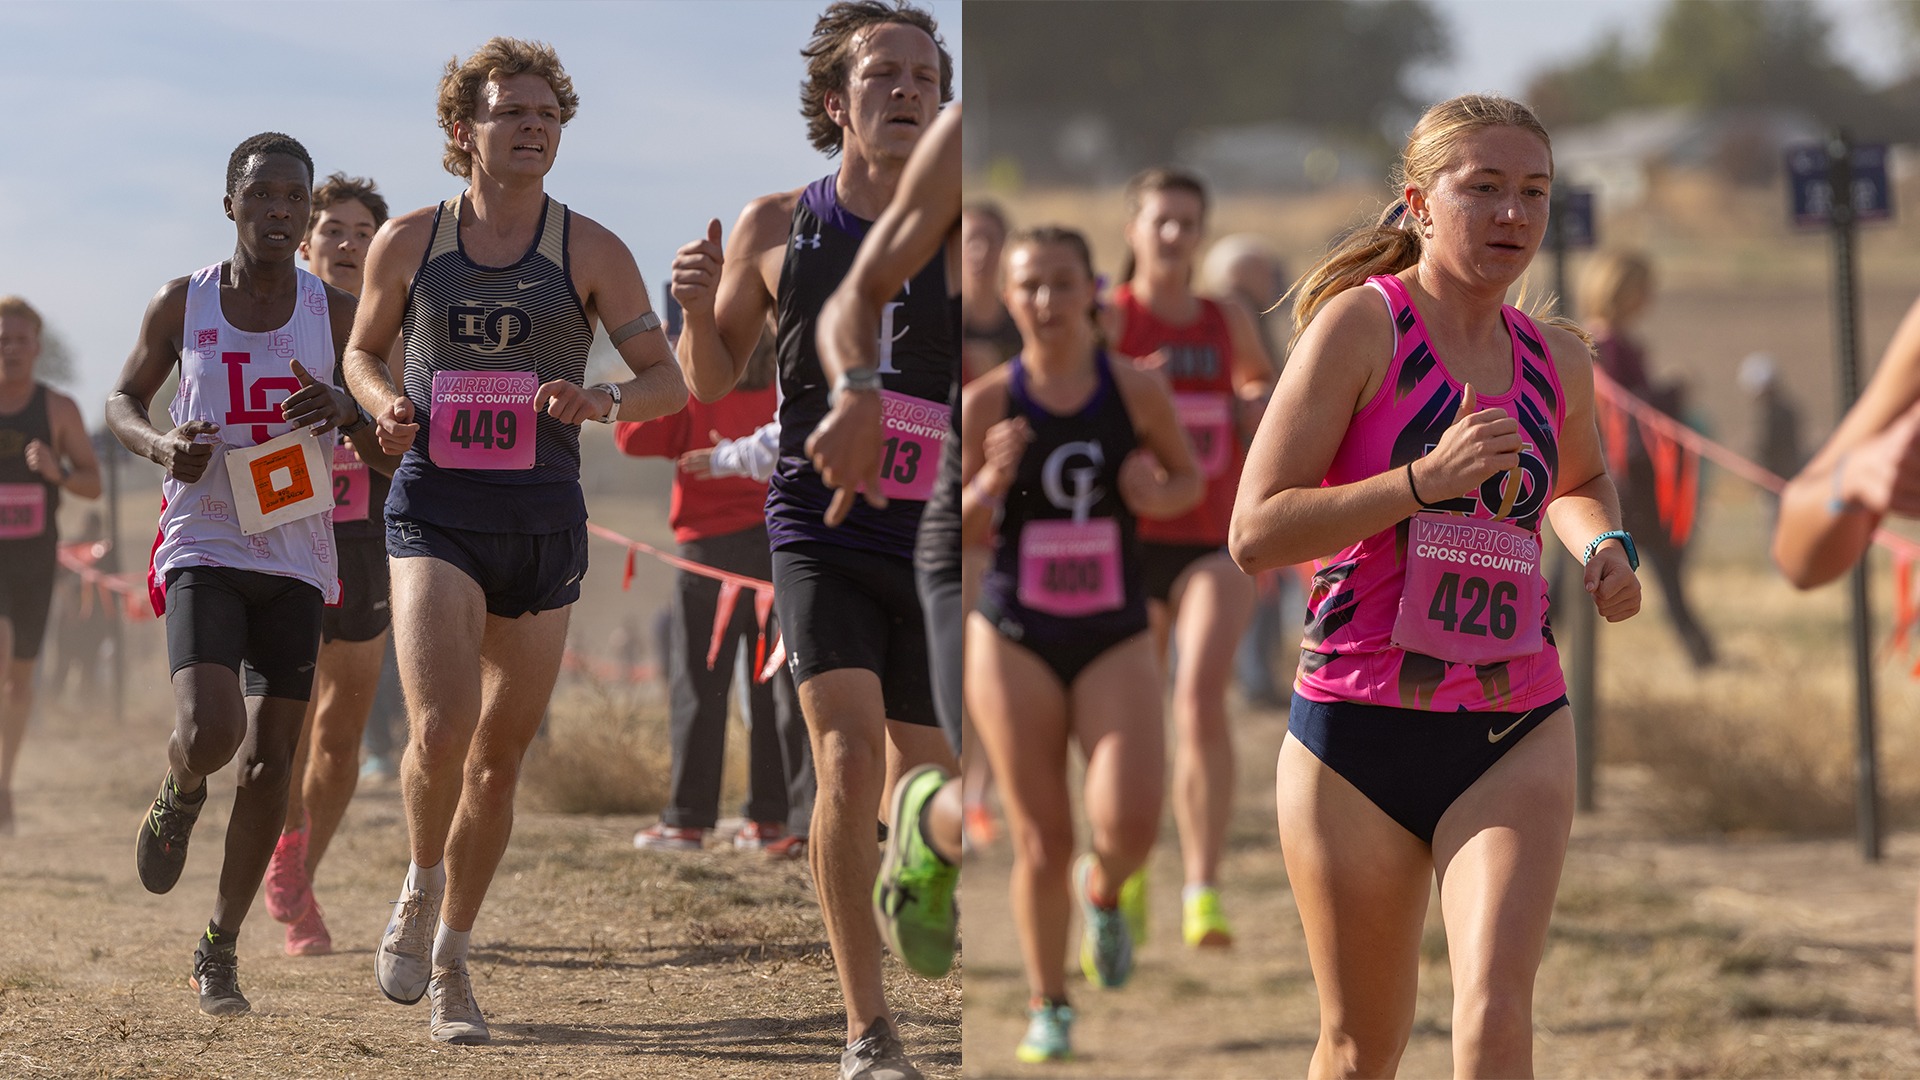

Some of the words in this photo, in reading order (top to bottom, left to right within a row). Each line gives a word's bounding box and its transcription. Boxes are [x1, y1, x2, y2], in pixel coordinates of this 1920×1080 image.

[436, 377, 534, 394] WARRIORS
[436, 393, 473, 404] CROSS
[476, 394, 532, 404] COUNTRY
[450, 410, 517, 450] 449
[886, 417, 949, 441] COUNTRY
[1415, 519, 1536, 561] WARRIORS
[1416, 544, 1467, 563] CROSS
[1469, 552, 1535, 576] COUNTRY
[1427, 572, 1518, 640] 426
